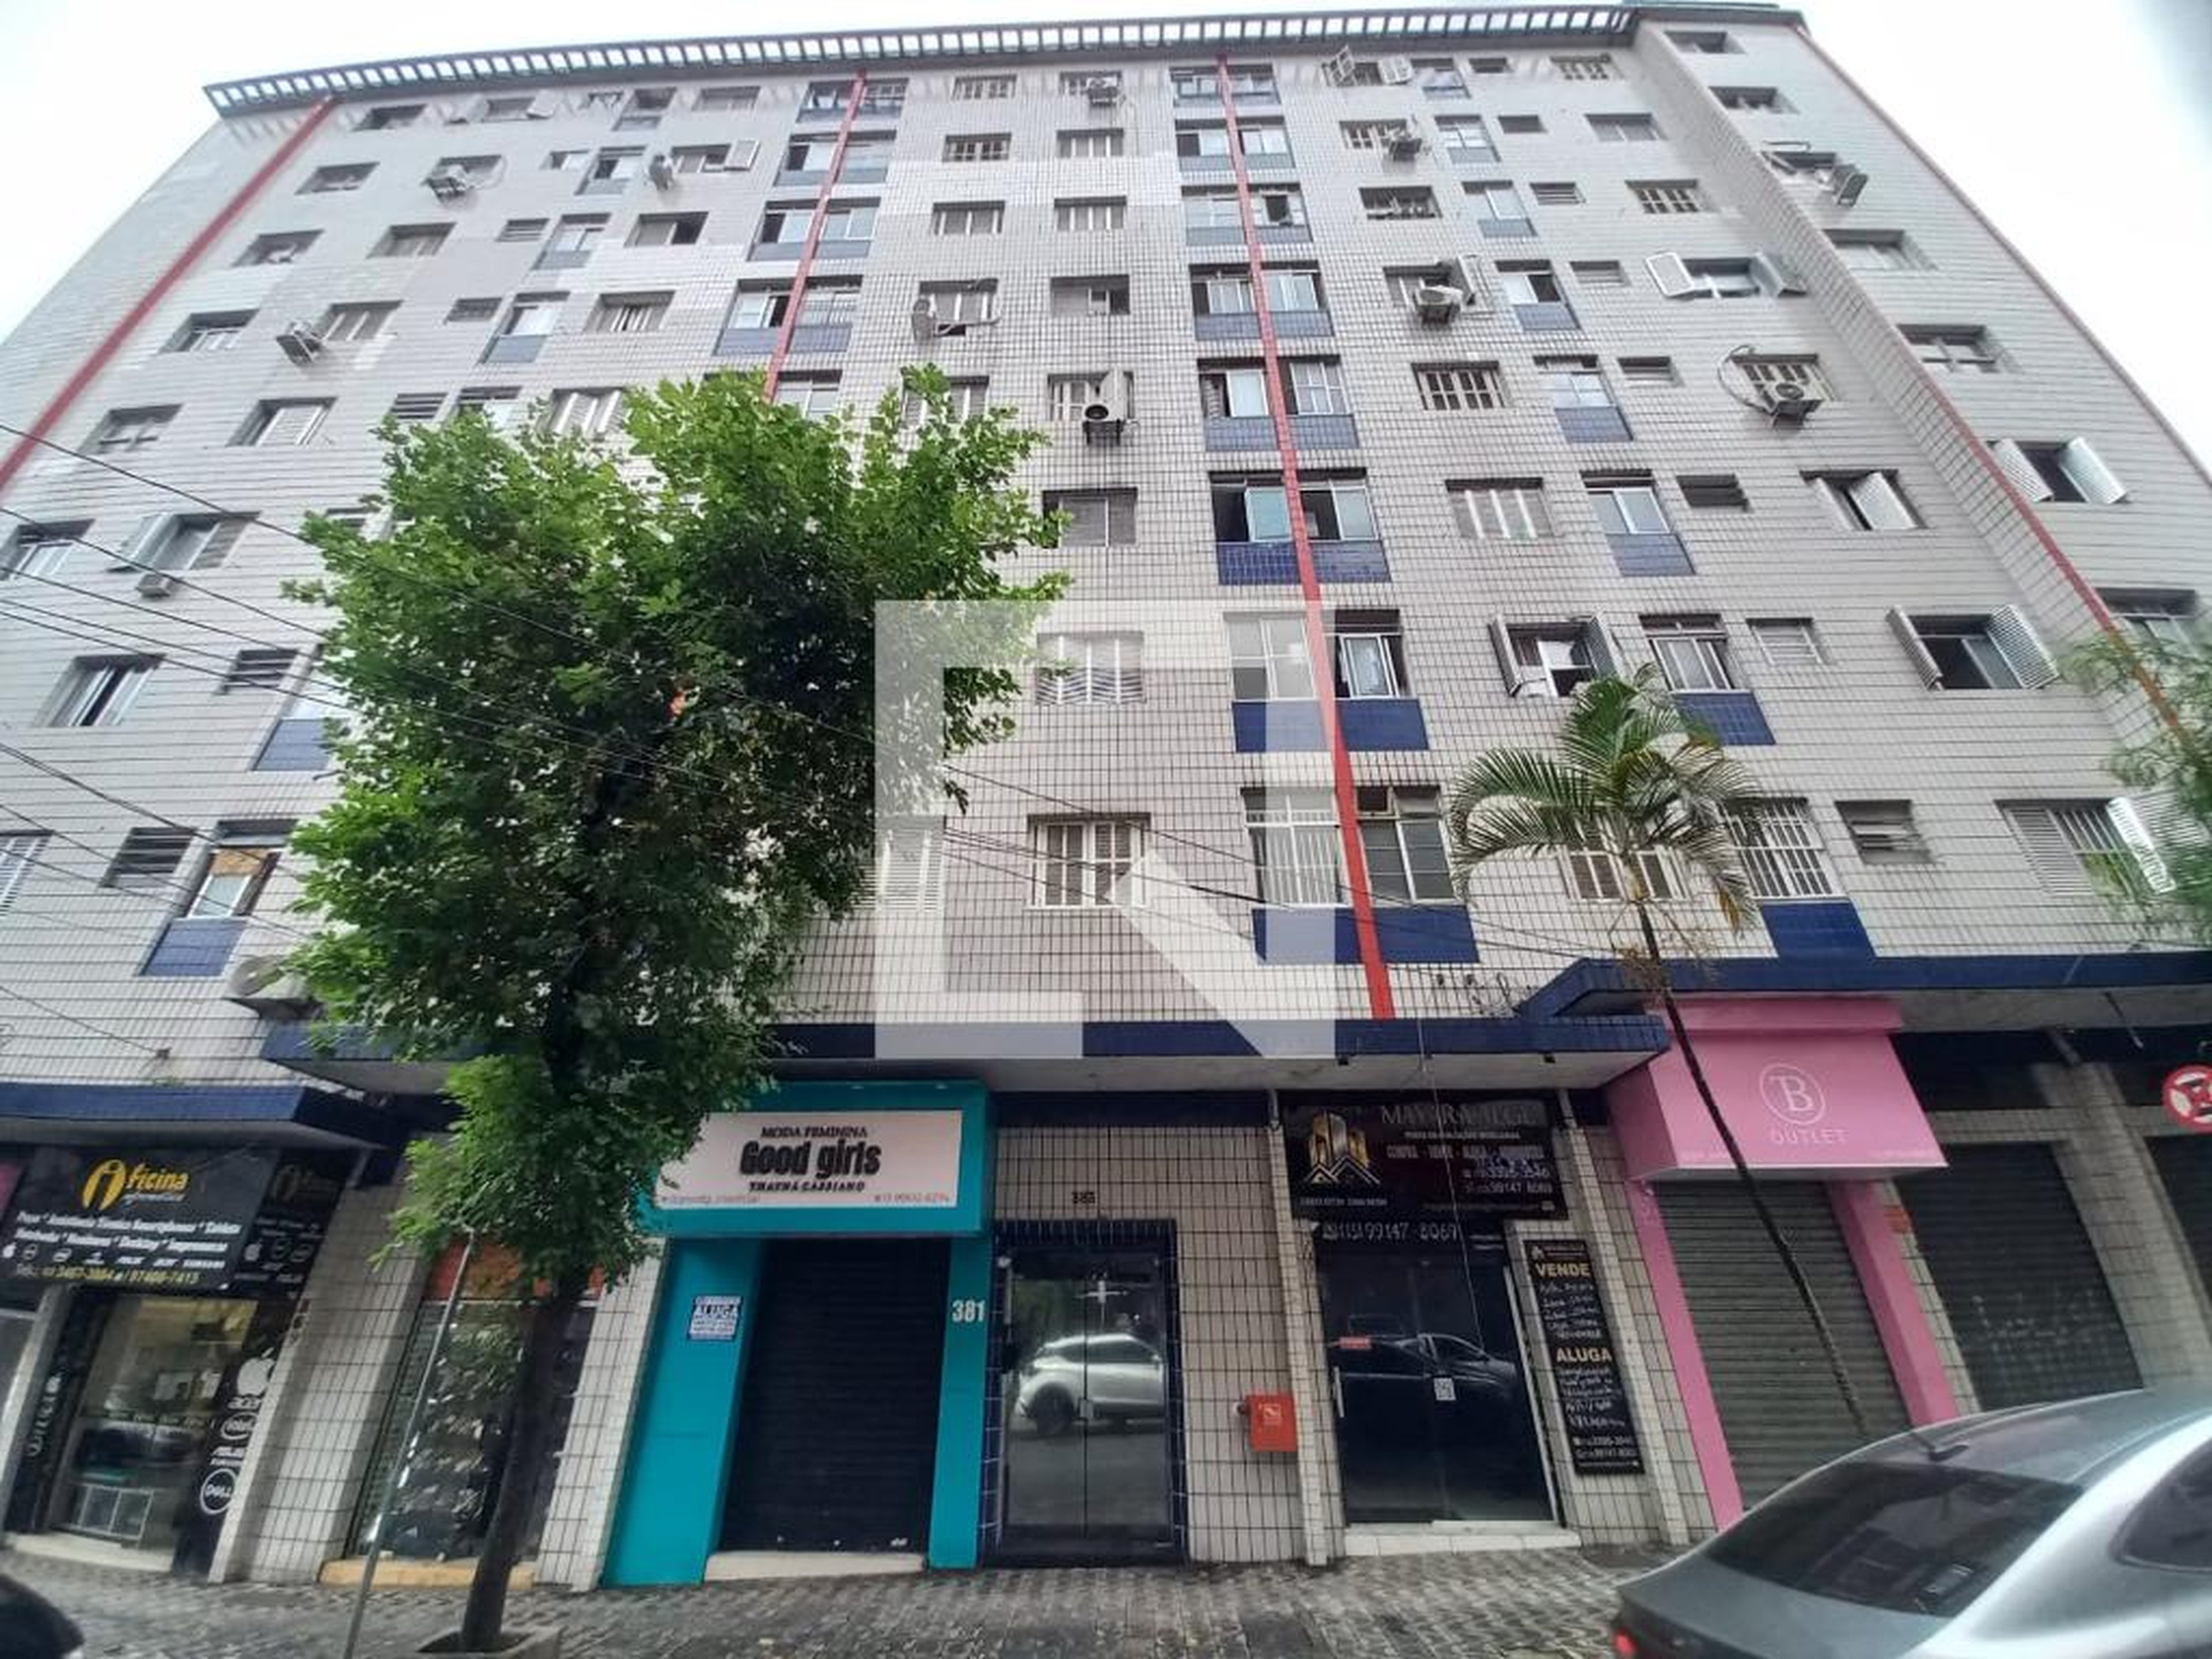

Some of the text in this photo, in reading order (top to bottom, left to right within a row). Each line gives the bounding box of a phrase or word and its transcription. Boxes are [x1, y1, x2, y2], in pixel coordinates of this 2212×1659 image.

[1768, 1075, 1814, 1112] B
[760, 1126, 868, 1139] MODA FEMININA
[1770, 1128, 1850, 1145] OUTLET
[740, 1138, 882, 1179] Good girls
[1535, 1263, 1591, 1278] VENDE
[952, 1299, 986, 1323] 381
[1556, 1347, 1612, 1363] ALUGA
